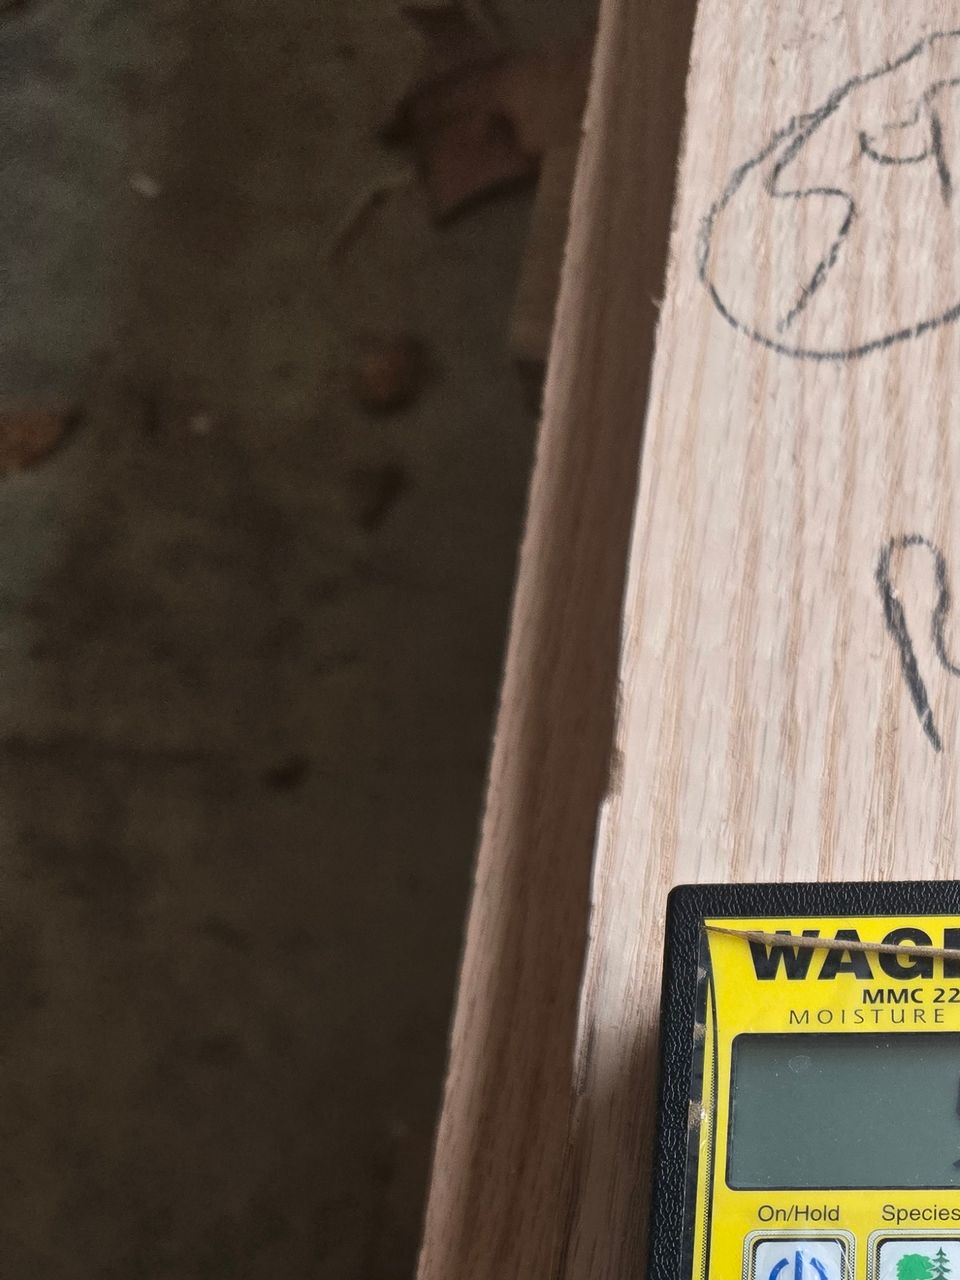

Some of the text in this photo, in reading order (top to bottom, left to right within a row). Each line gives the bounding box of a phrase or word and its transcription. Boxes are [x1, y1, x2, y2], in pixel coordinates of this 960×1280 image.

[862, 987, 924, 1005] MMC
[788, 1008, 945, 1026] MOISTURE
[757, 1204, 840, 1223] On/Hold
